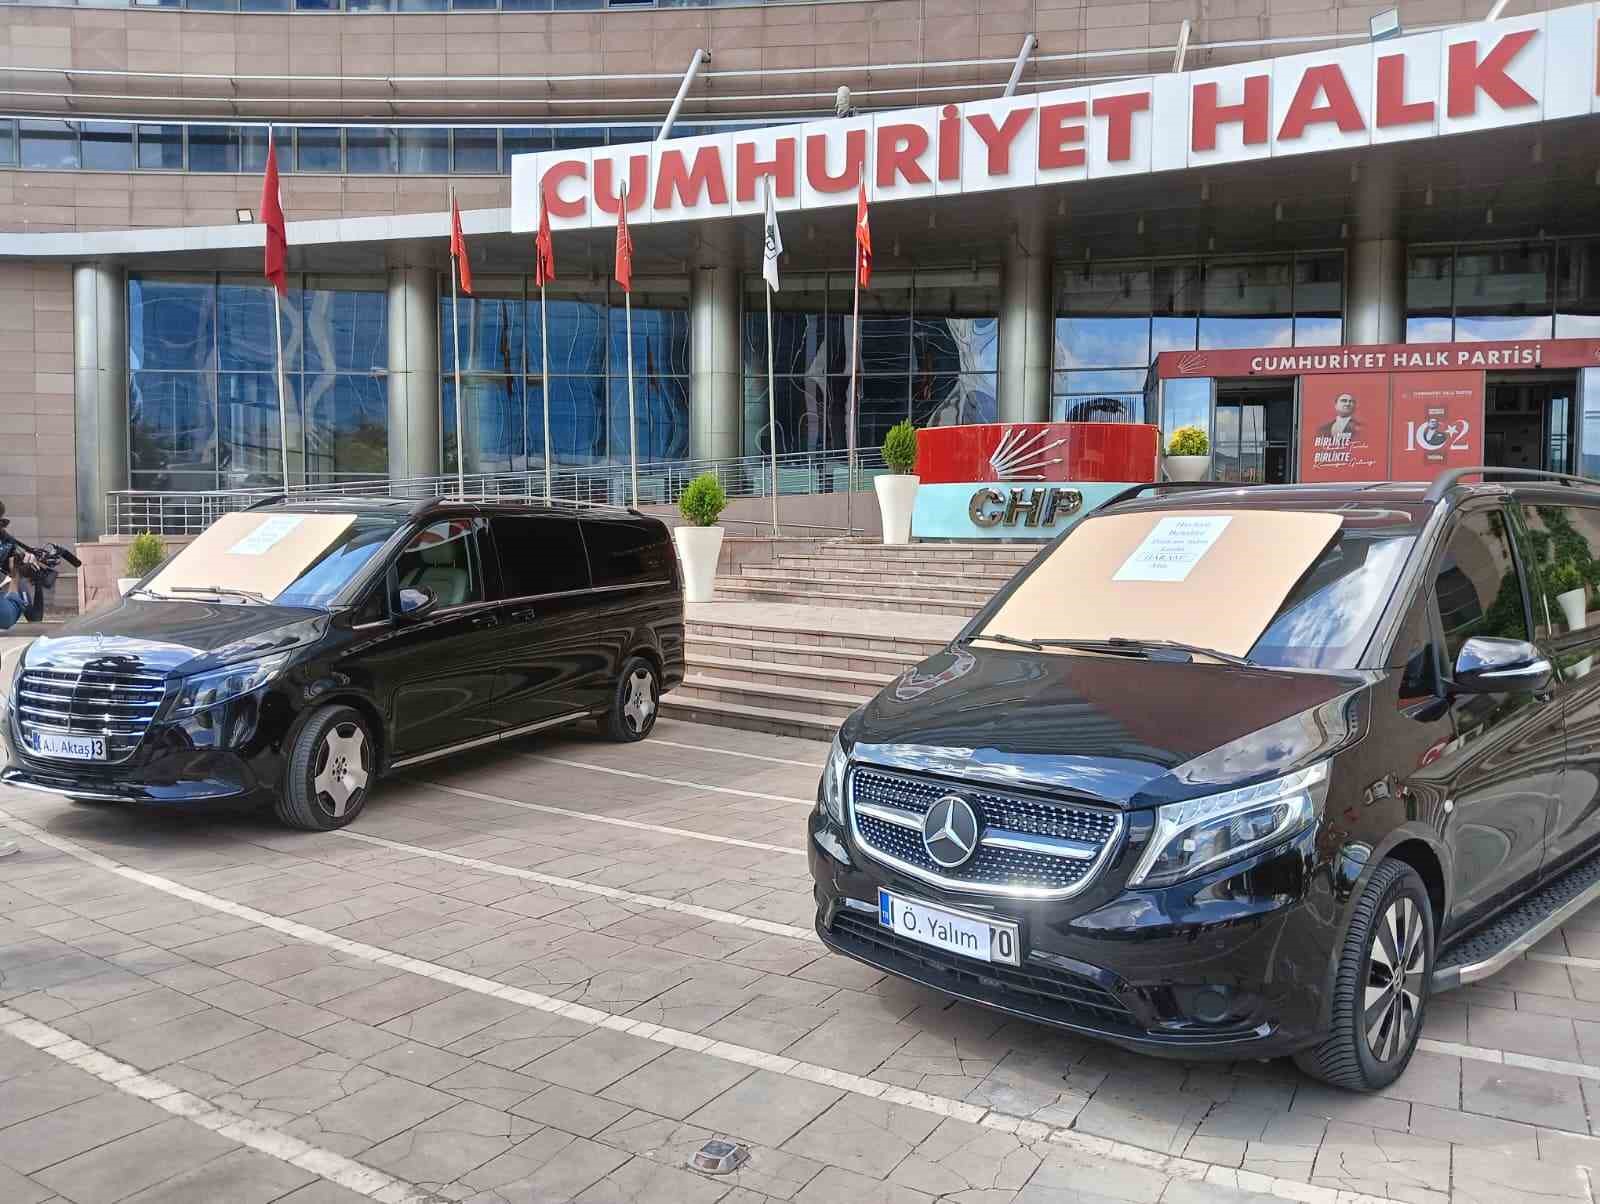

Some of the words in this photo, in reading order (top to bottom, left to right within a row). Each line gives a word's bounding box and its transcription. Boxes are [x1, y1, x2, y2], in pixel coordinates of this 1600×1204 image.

[541, 92, 1150, 218] CUMHURİYET
[1192, 28, 1539, 153] HALK
[1251, 350, 1386, 371] CUMHURİYET
[1393, 351, 1449, 367] HALK
[1457, 344, 1541, 366] PARTİSİ
[968, 487, 1083, 528] CHP
[61, 740, 90, 758] Aktaş
[903, 906, 922, 934] Ö.
[928, 917, 978, 950] Yalım
